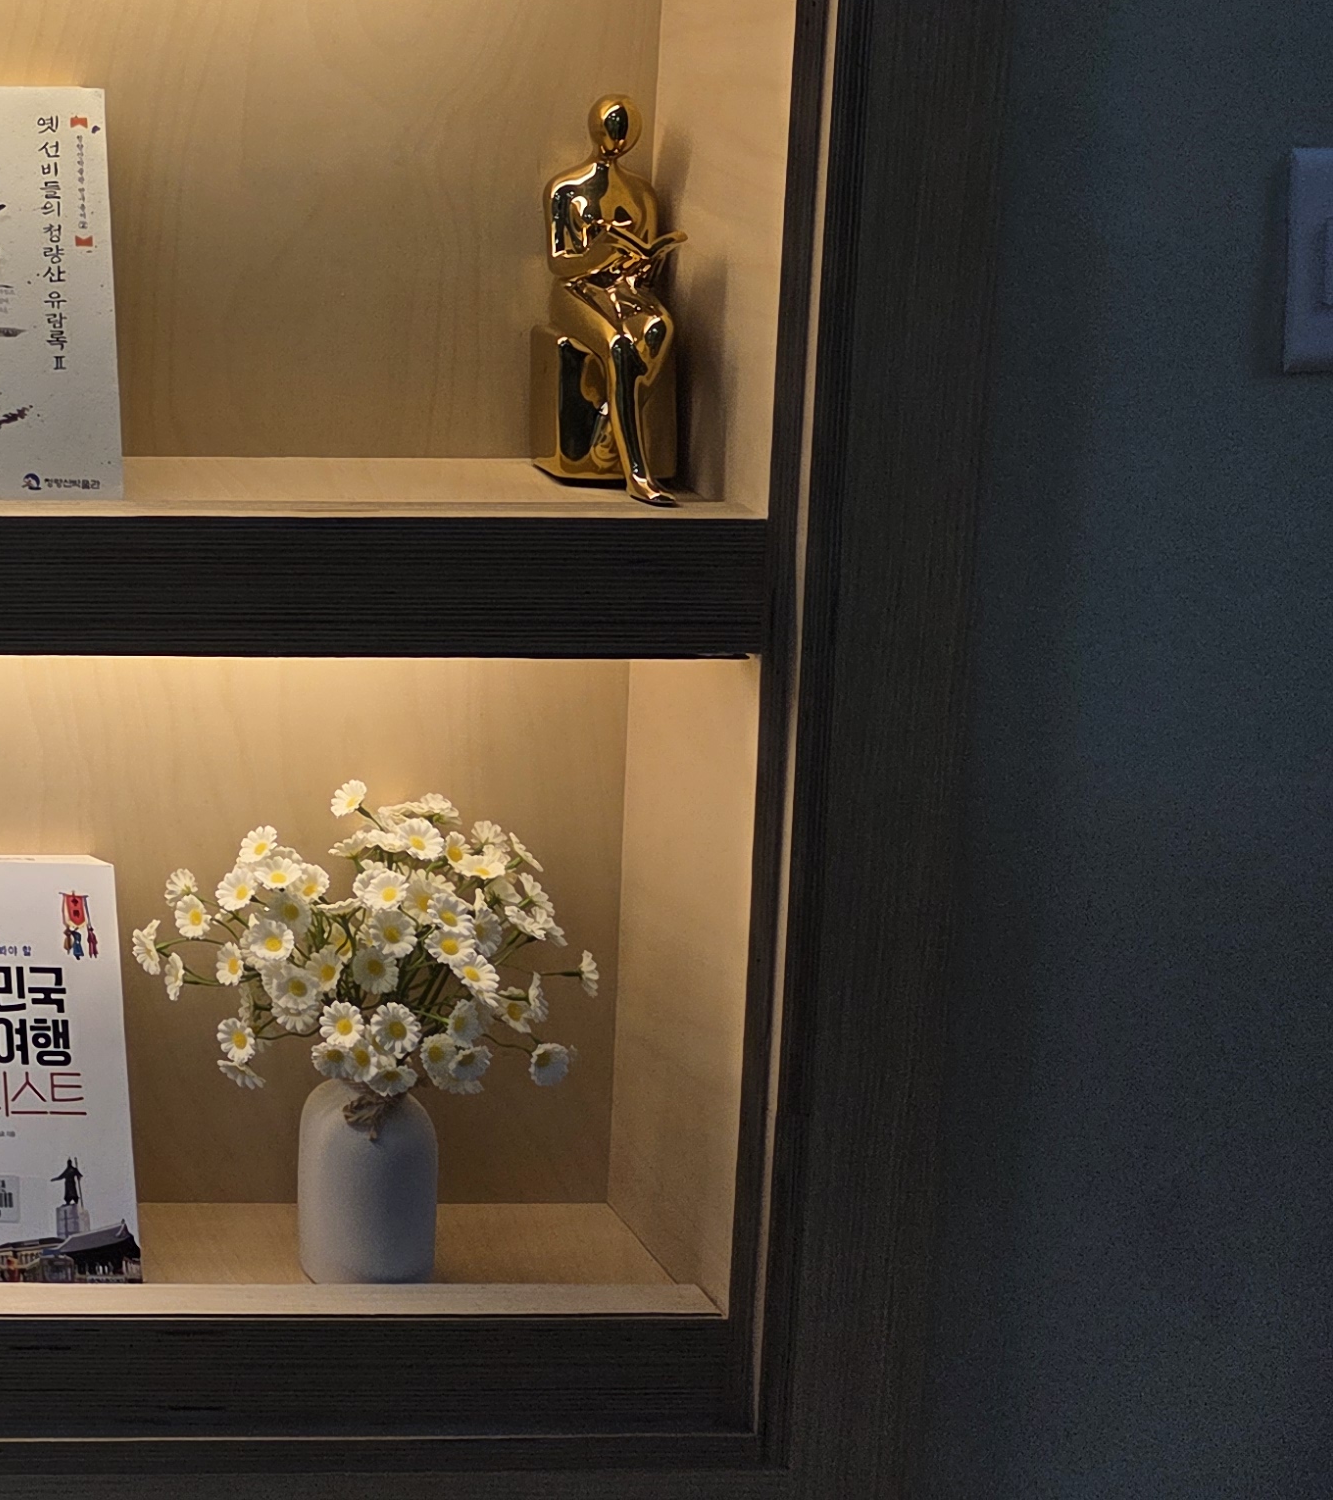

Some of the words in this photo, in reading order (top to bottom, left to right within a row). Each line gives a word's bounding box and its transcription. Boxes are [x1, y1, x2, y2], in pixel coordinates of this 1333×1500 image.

[37, 115, 59, 134] 옛
[38, 140, 61, 217] 선비들의
[43, 223, 66, 283] 청량산
[44, 291, 68, 351] 유람록
